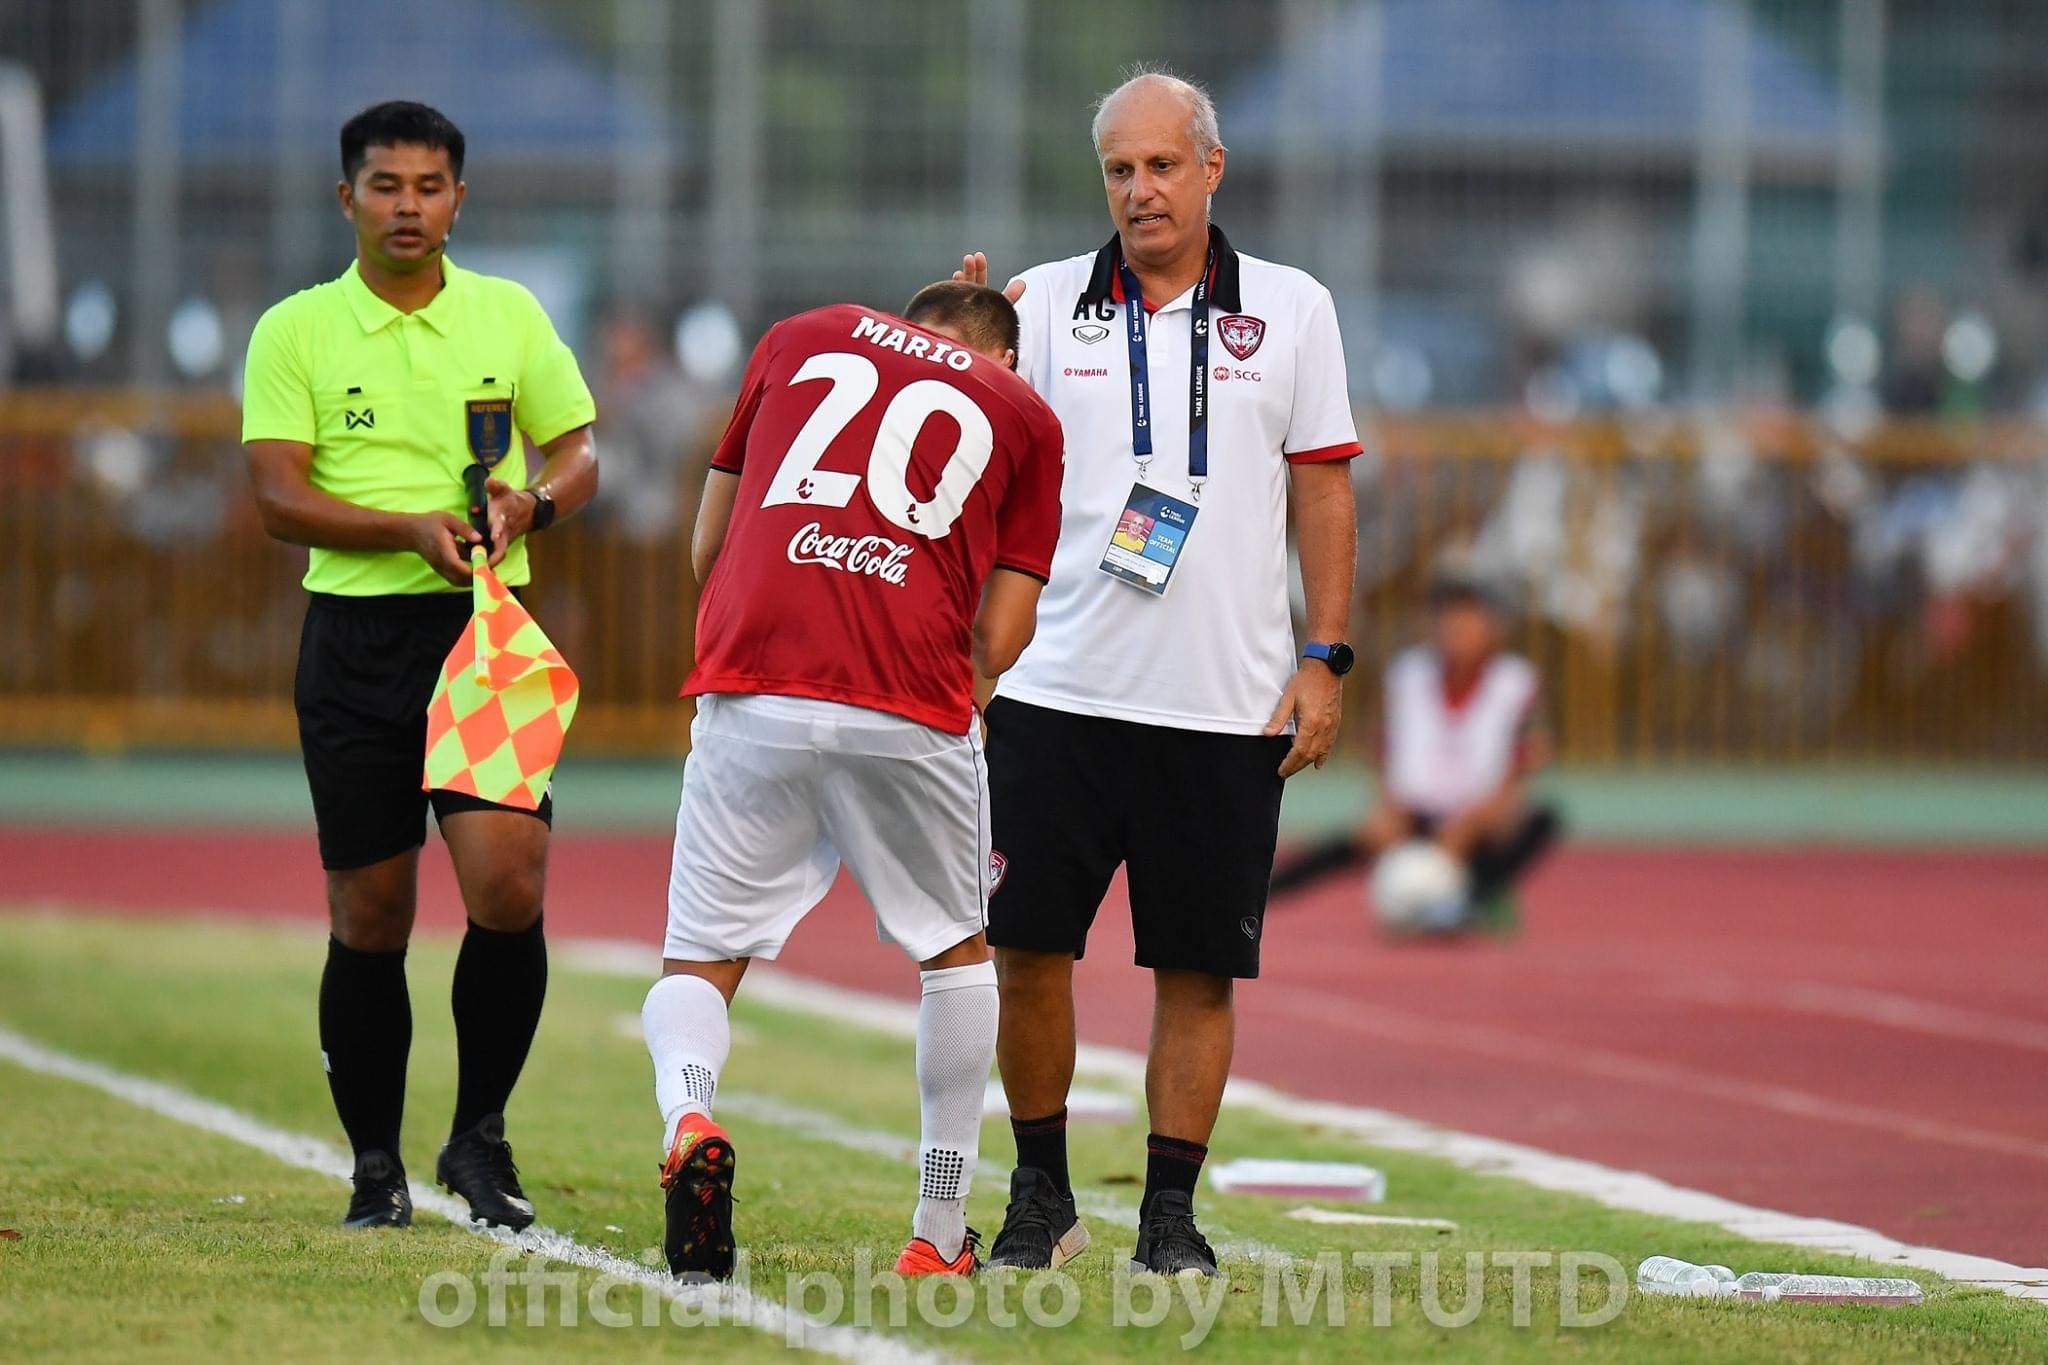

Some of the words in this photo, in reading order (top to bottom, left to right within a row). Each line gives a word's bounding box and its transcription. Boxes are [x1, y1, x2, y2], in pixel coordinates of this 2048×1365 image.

[851, 316, 973, 372] MARIO
[1073, 367, 1108, 377] YAMAHA
[1195, 365, 1204, 395] LEAGUE
[1234, 369, 1262, 382] SCG
[1195, 397, 1203, 418] THAI
[760, 352, 994, 540] 20
